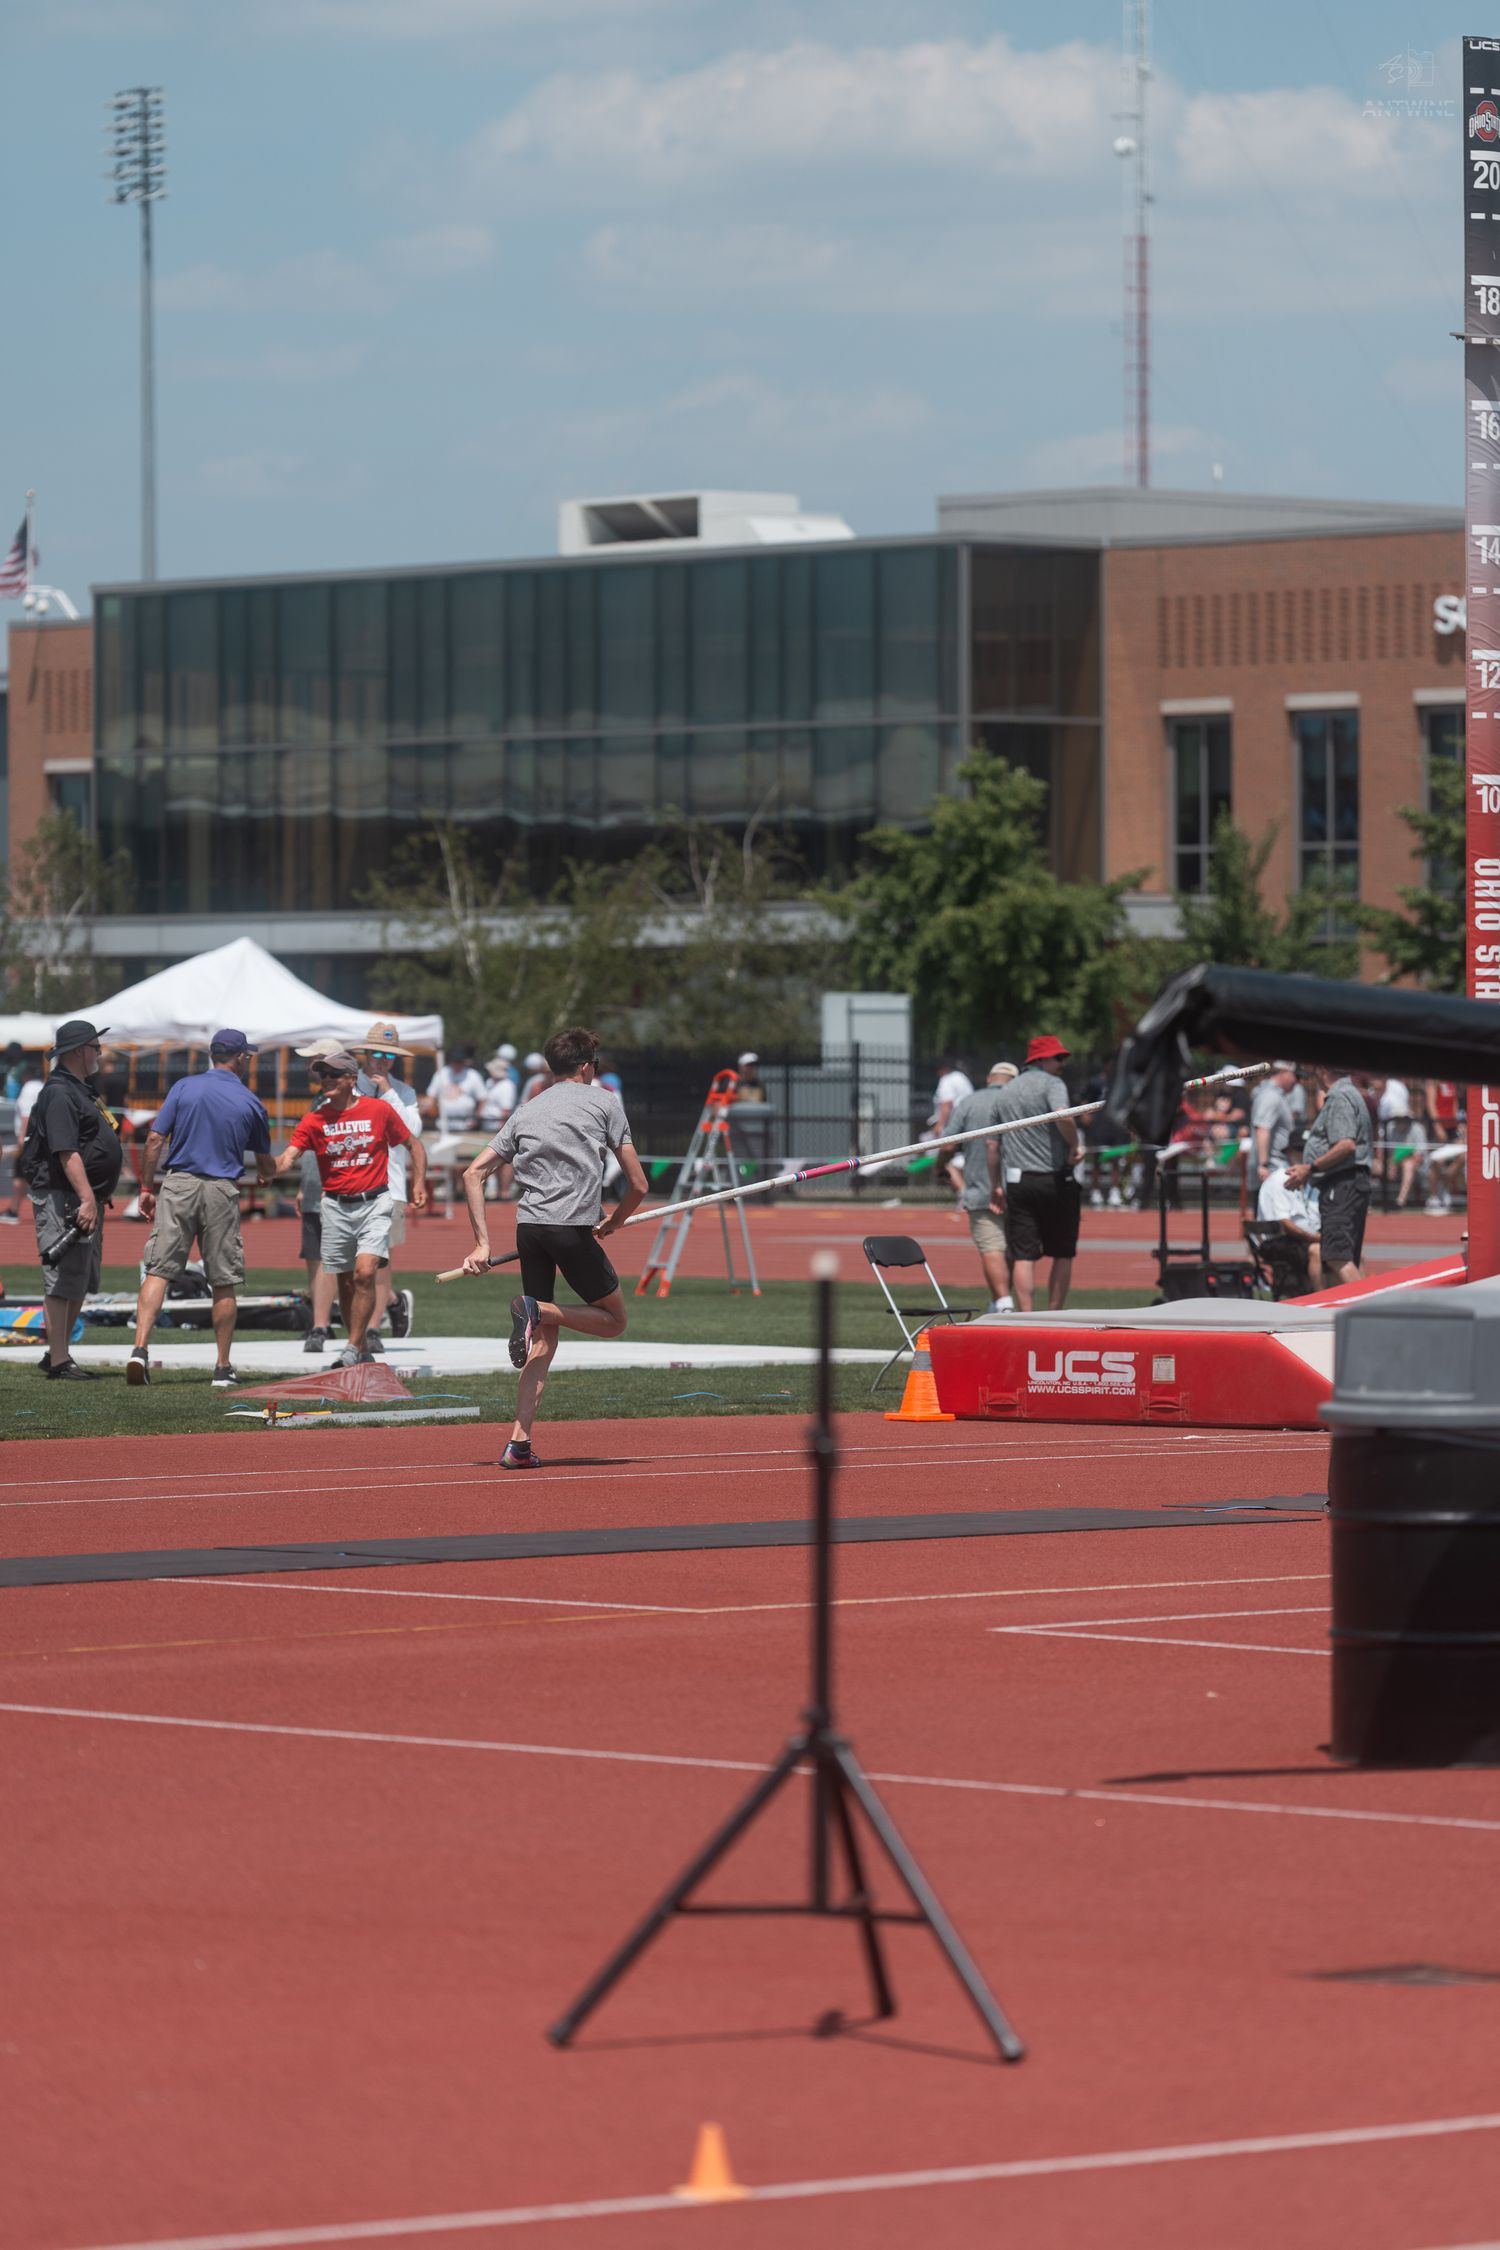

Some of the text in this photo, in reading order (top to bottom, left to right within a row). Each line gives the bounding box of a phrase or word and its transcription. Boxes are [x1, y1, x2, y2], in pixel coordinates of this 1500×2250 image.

[1470, 40, 1500, 51] UCS
[1473, 160, 1500, 190] 20
[1474, 286, 1500, 316] 18
[1474, 411, 1500, 440] 16
[1474, 536, 1500, 565] 14
[1475, 661, 1500, 688] 12
[1476, 786, 1500, 813] 10
[1474, 858, 1500, 1003] OHIO STA
[322, 1120, 372, 1137] BELLEVUE
[1028, 1350, 1136, 1383] UCS
[1027, 1385, 1136, 1396] WWW.UCSSPIRIT.COM
